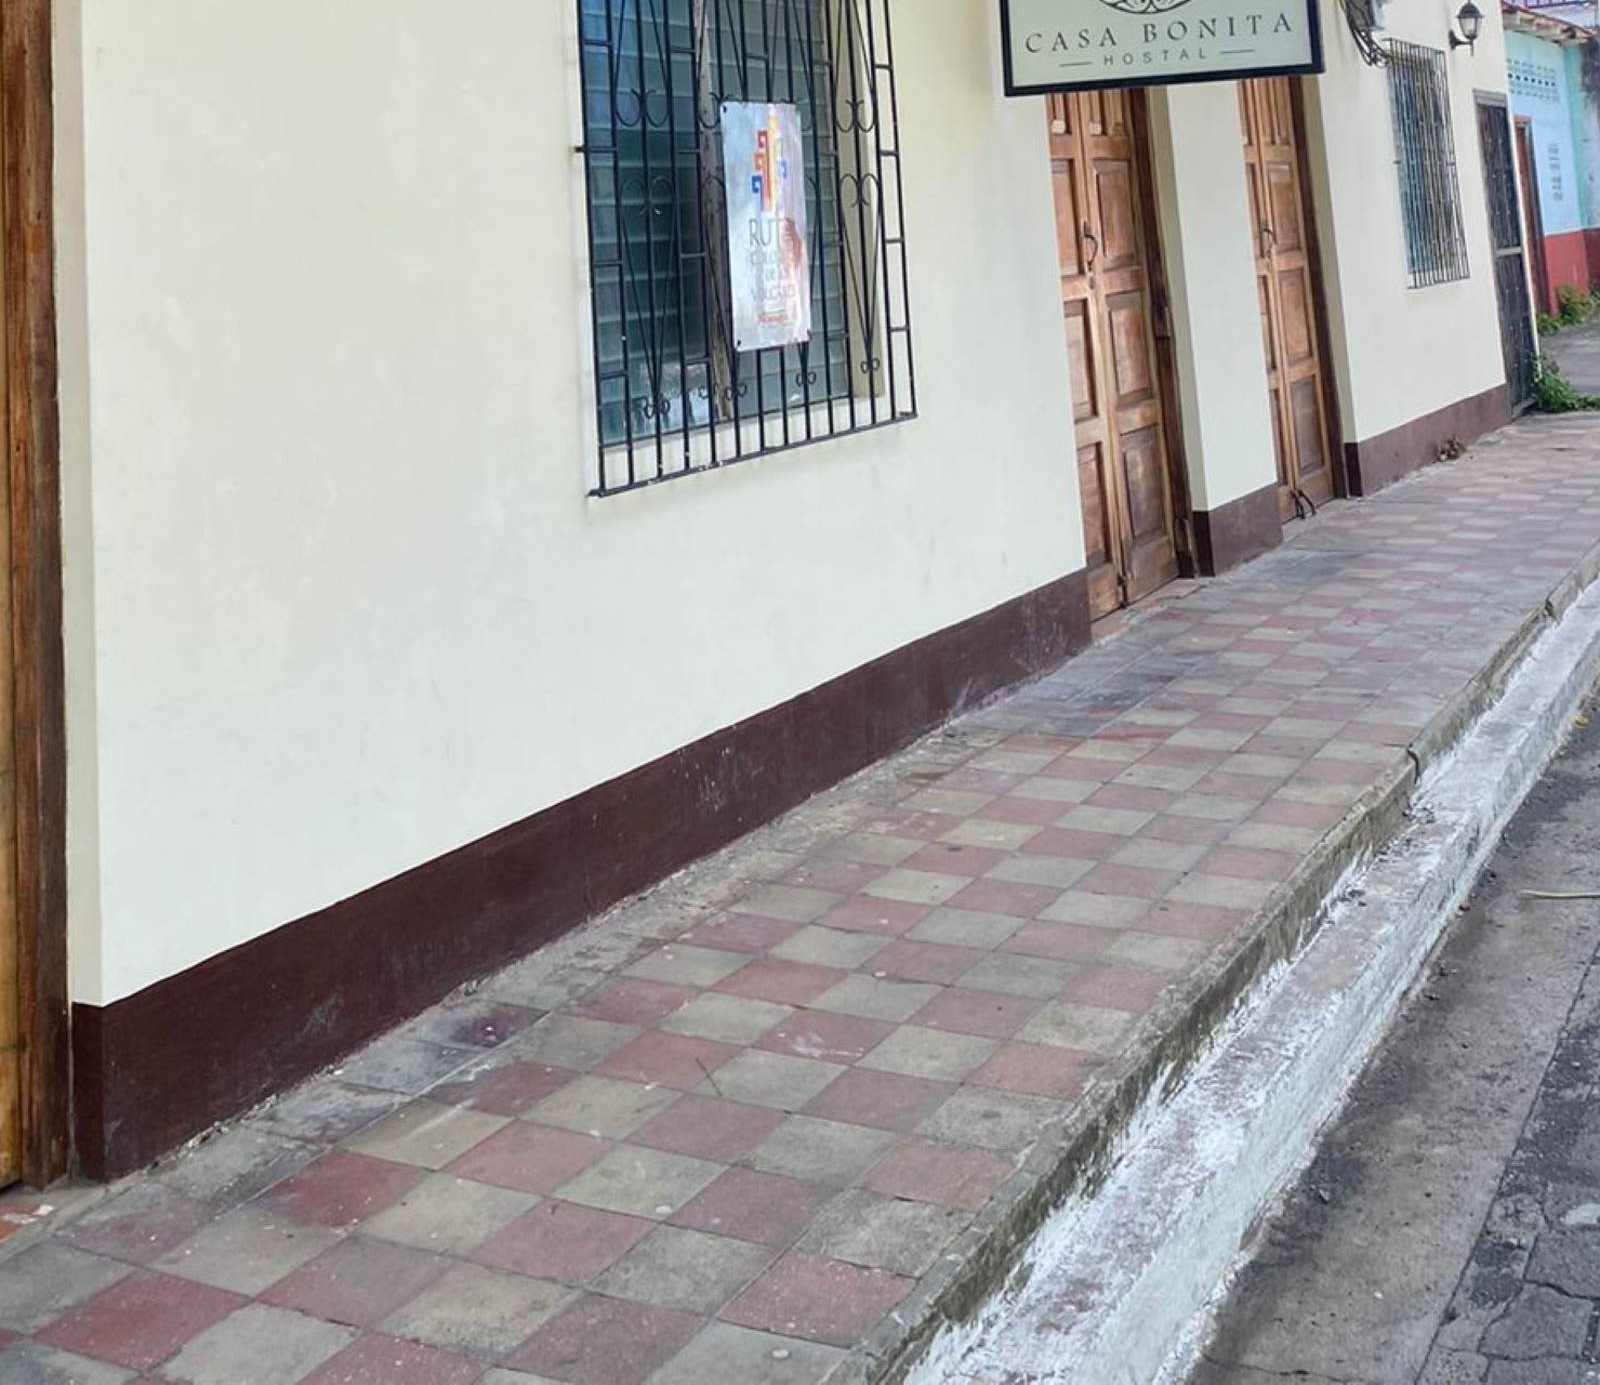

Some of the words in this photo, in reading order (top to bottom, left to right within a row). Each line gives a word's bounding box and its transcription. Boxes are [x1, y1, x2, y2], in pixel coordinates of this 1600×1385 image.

[1025, 26, 1118, 54] CASA
[1143, 12, 1292, 44] BONITA
[1104, 47, 1208, 66] HOSTAL
